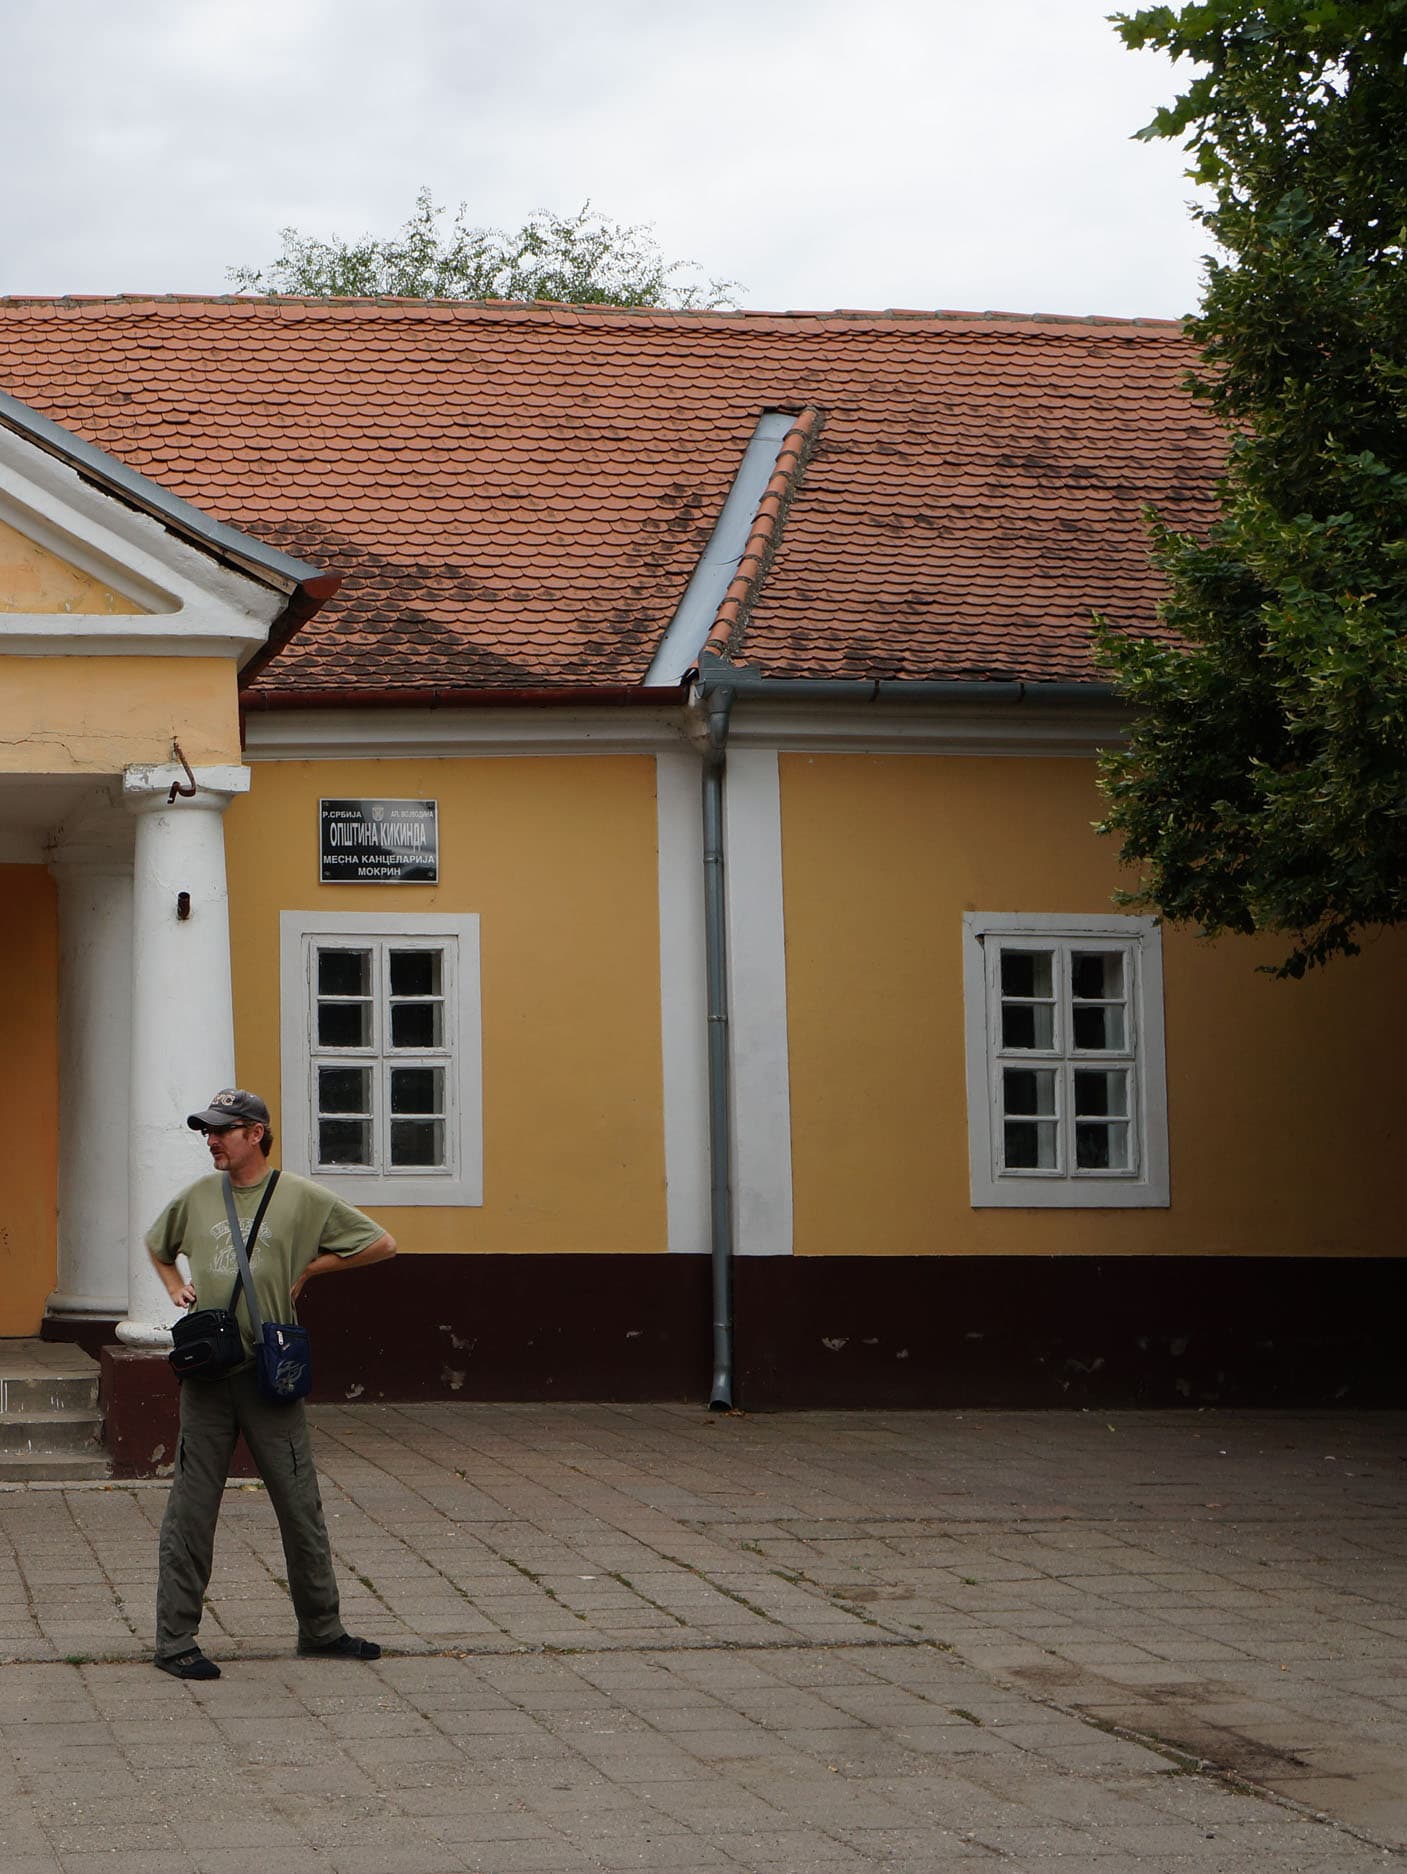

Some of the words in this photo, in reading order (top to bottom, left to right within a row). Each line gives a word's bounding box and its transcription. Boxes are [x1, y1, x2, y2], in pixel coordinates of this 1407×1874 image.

[330, 822, 378, 846] ОПШТИНА
[380, 822, 427, 852] КИКИНДА
[323, 855, 359, 864] МЕСНА
[361, 855, 435, 866] КАНЦЕЛАРИЈА
[358, 867, 401, 876] МОКРИН
